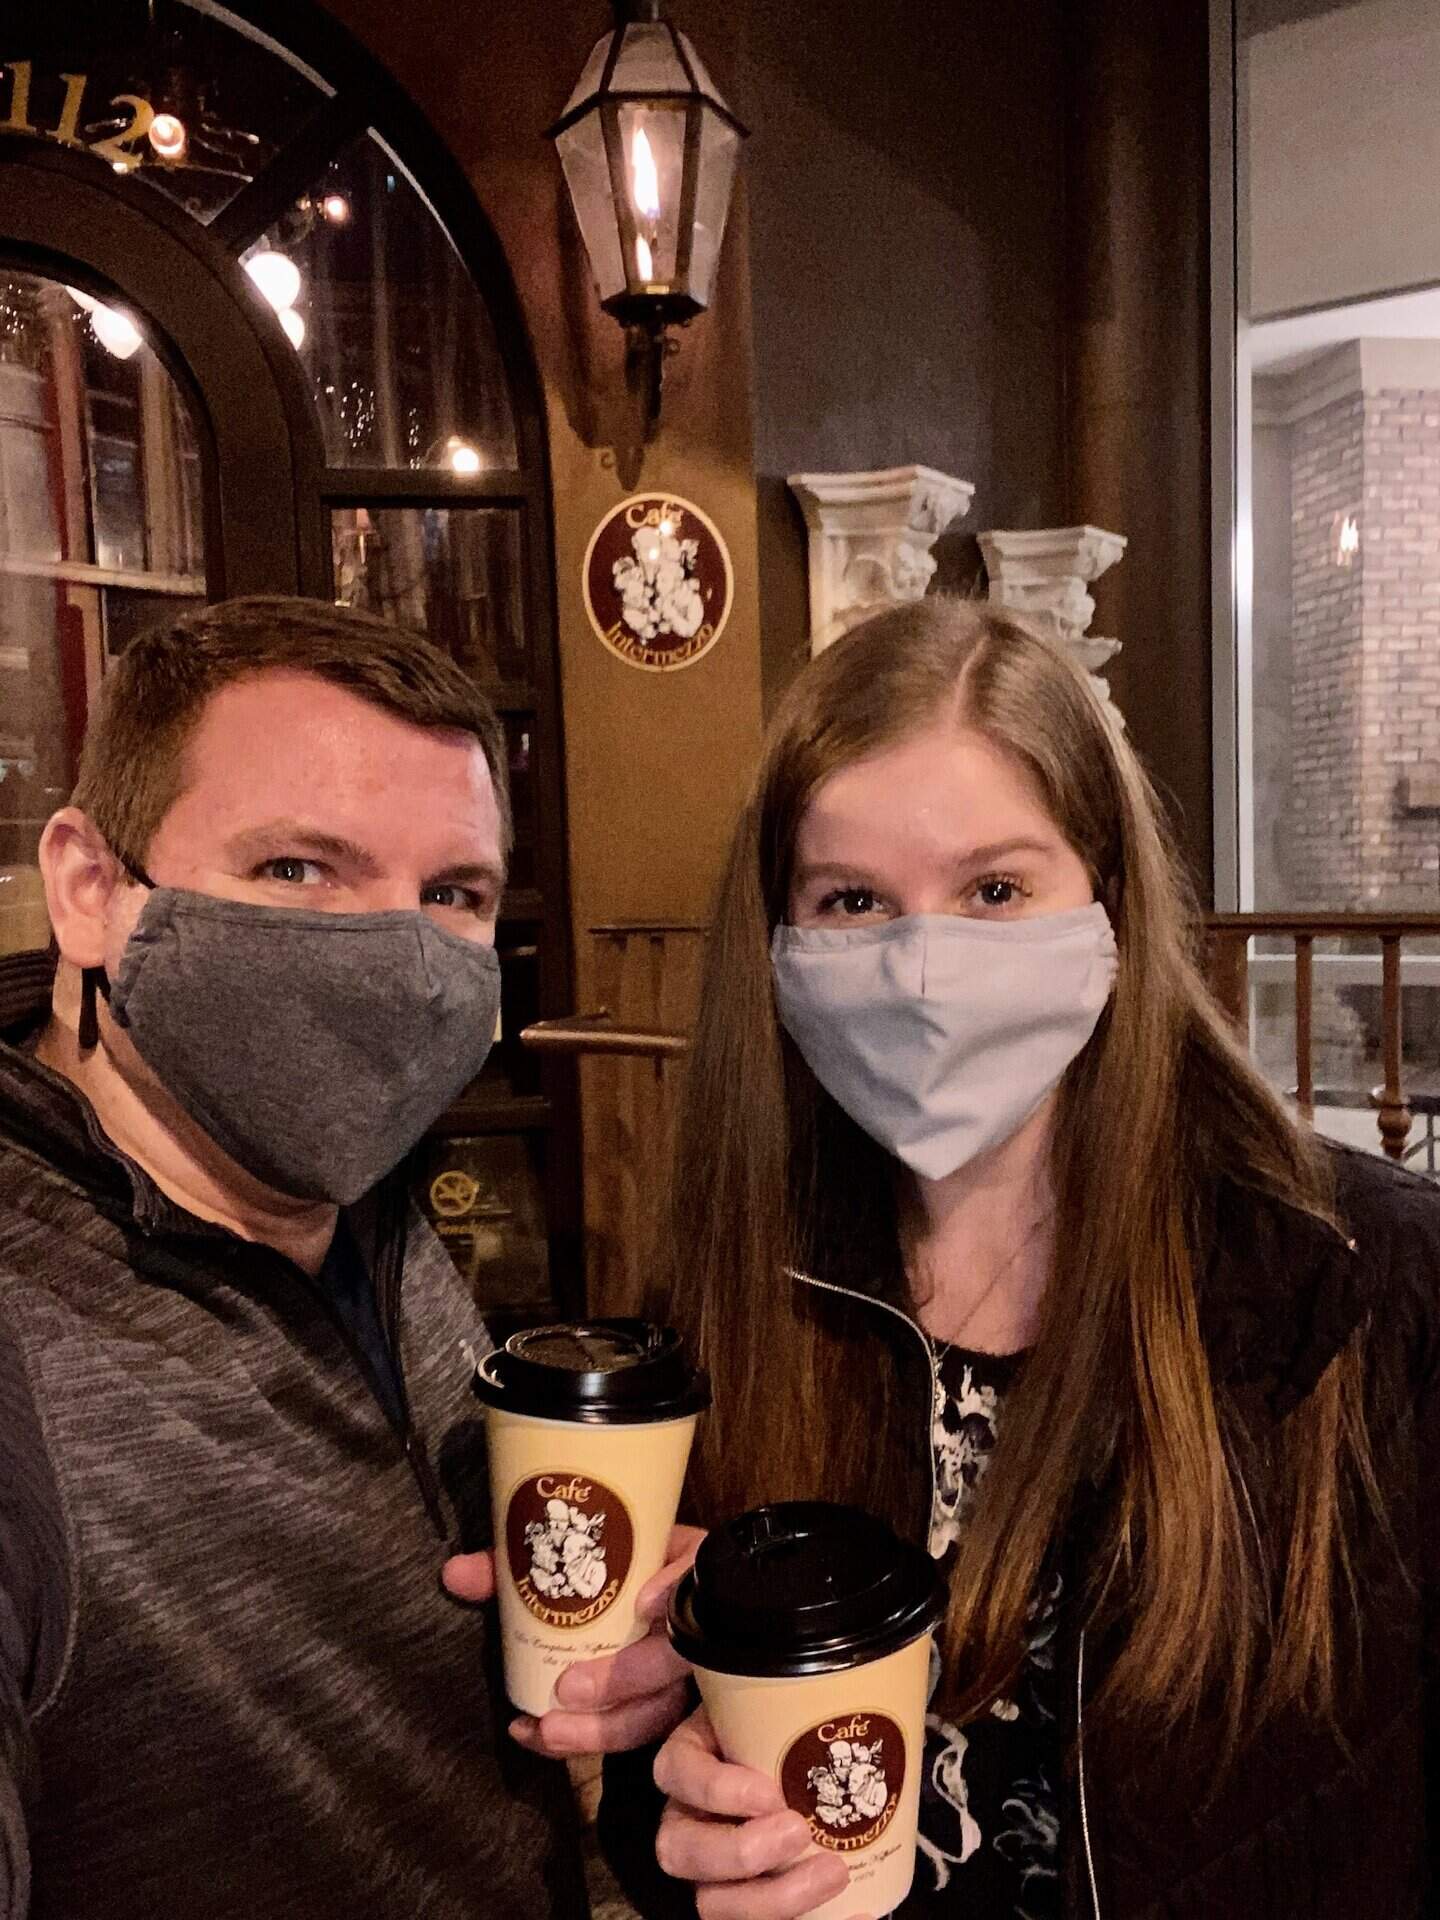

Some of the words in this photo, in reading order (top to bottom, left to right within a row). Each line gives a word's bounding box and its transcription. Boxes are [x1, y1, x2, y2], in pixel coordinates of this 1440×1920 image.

[0, 60, 155, 171] 112
[536, 1476, 592, 1503] Café
[817, 1715, 871, 1743] Café
